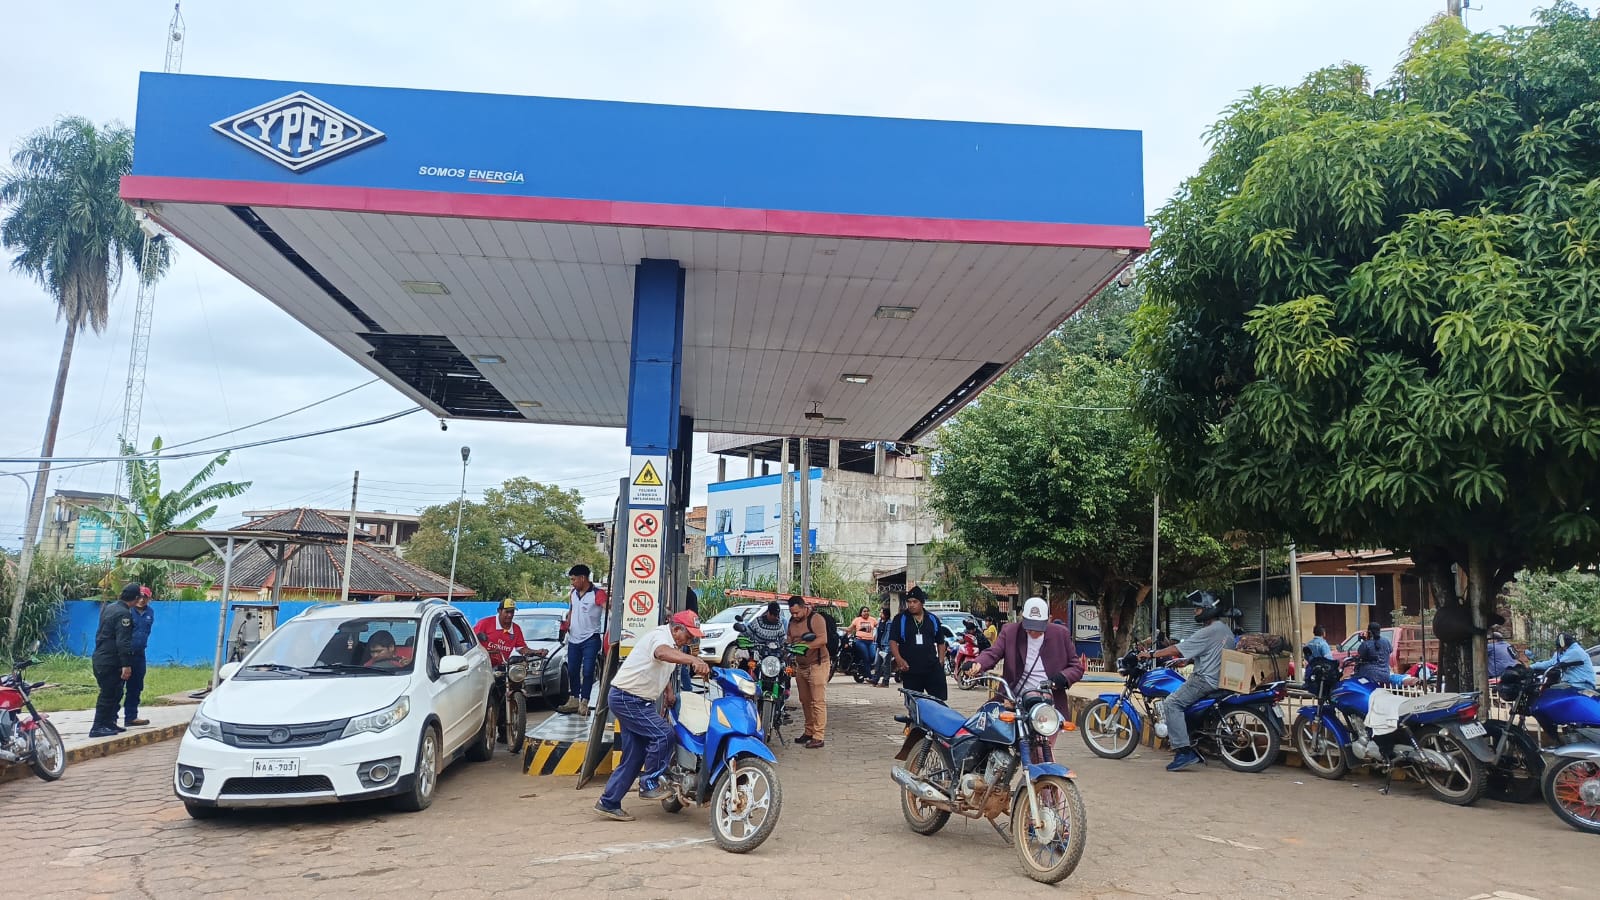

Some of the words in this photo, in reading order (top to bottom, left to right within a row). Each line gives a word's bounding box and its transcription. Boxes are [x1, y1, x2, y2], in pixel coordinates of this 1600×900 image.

[253, 105, 344, 153] YPFB
[418, 165, 466, 178] SOMOS
[467, 169, 525, 182] ENERGÍA
